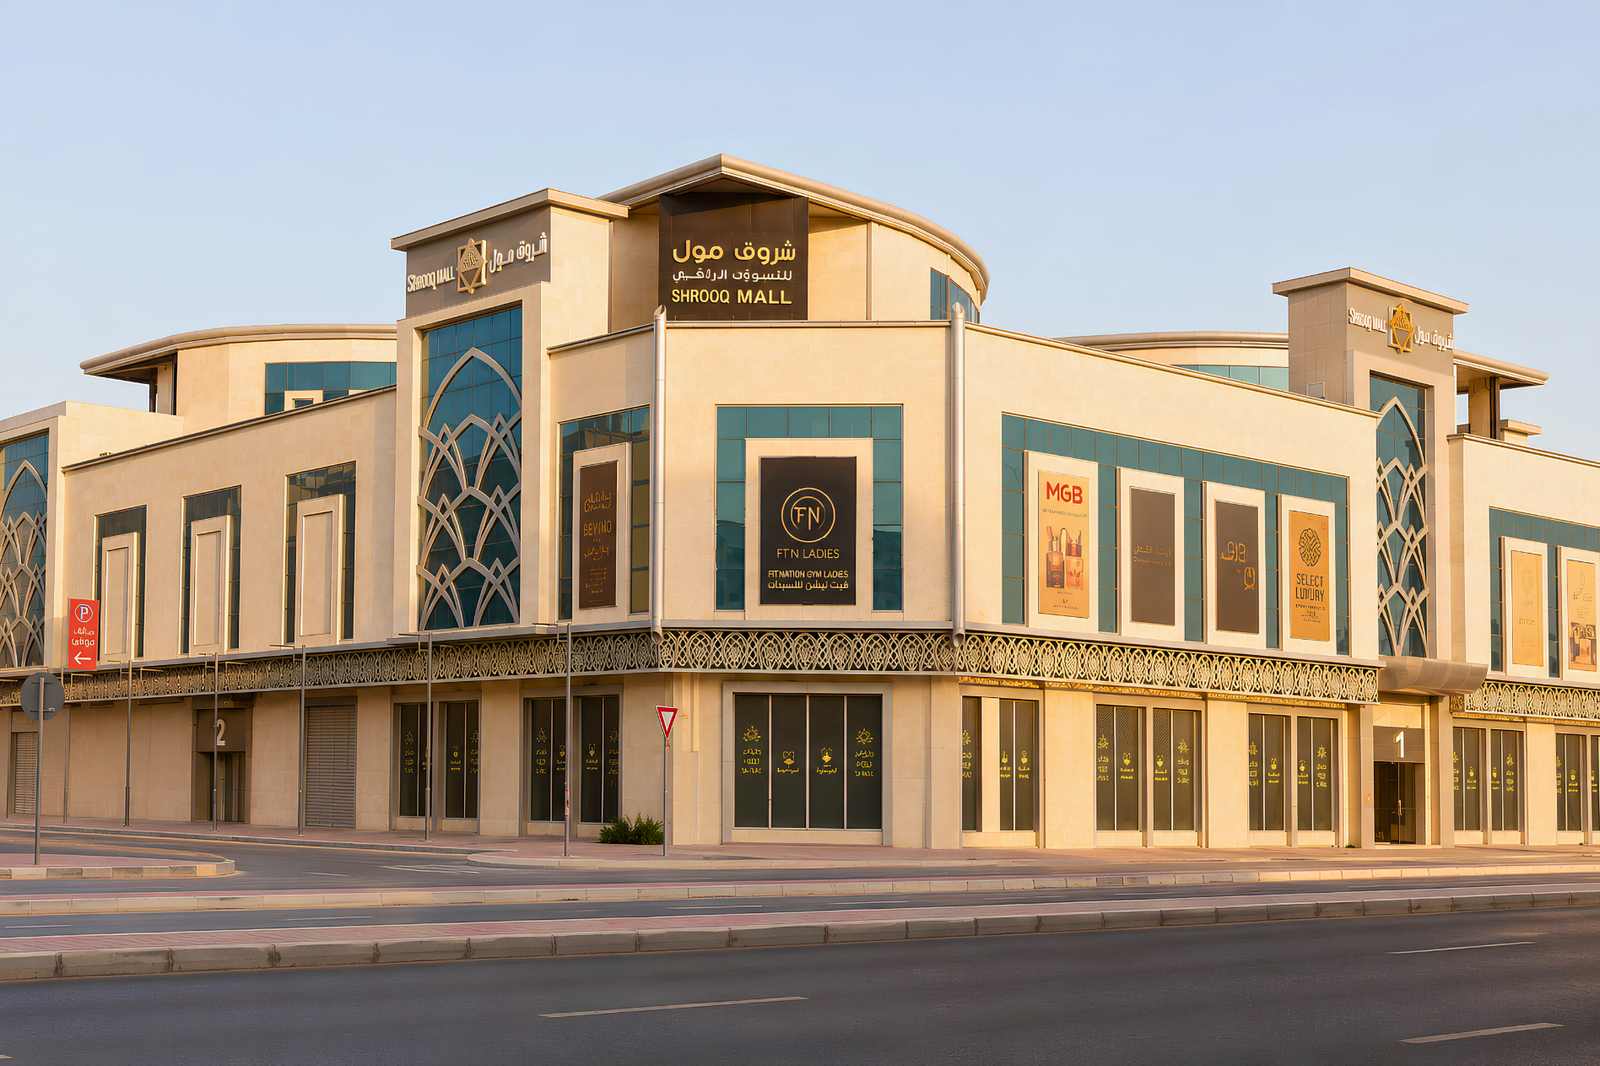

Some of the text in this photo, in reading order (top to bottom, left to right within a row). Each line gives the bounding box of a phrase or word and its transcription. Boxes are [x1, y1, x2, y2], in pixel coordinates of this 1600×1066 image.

[489, 232, 547, 273] شروق مول
[672, 239, 796, 265] شروق مول
[671, 289, 792, 305] SHROOQ MALL
[1046, 481, 1083, 505] MGB
[776, 548, 840, 559] FTN LADIES
[806, 569, 822, 578] GYM
[1296, 572, 1324, 588] SELECT
[80, 606, 89, 621] P
[216, 718, 226, 746] 2
[1394, 730, 1405, 759] 1
